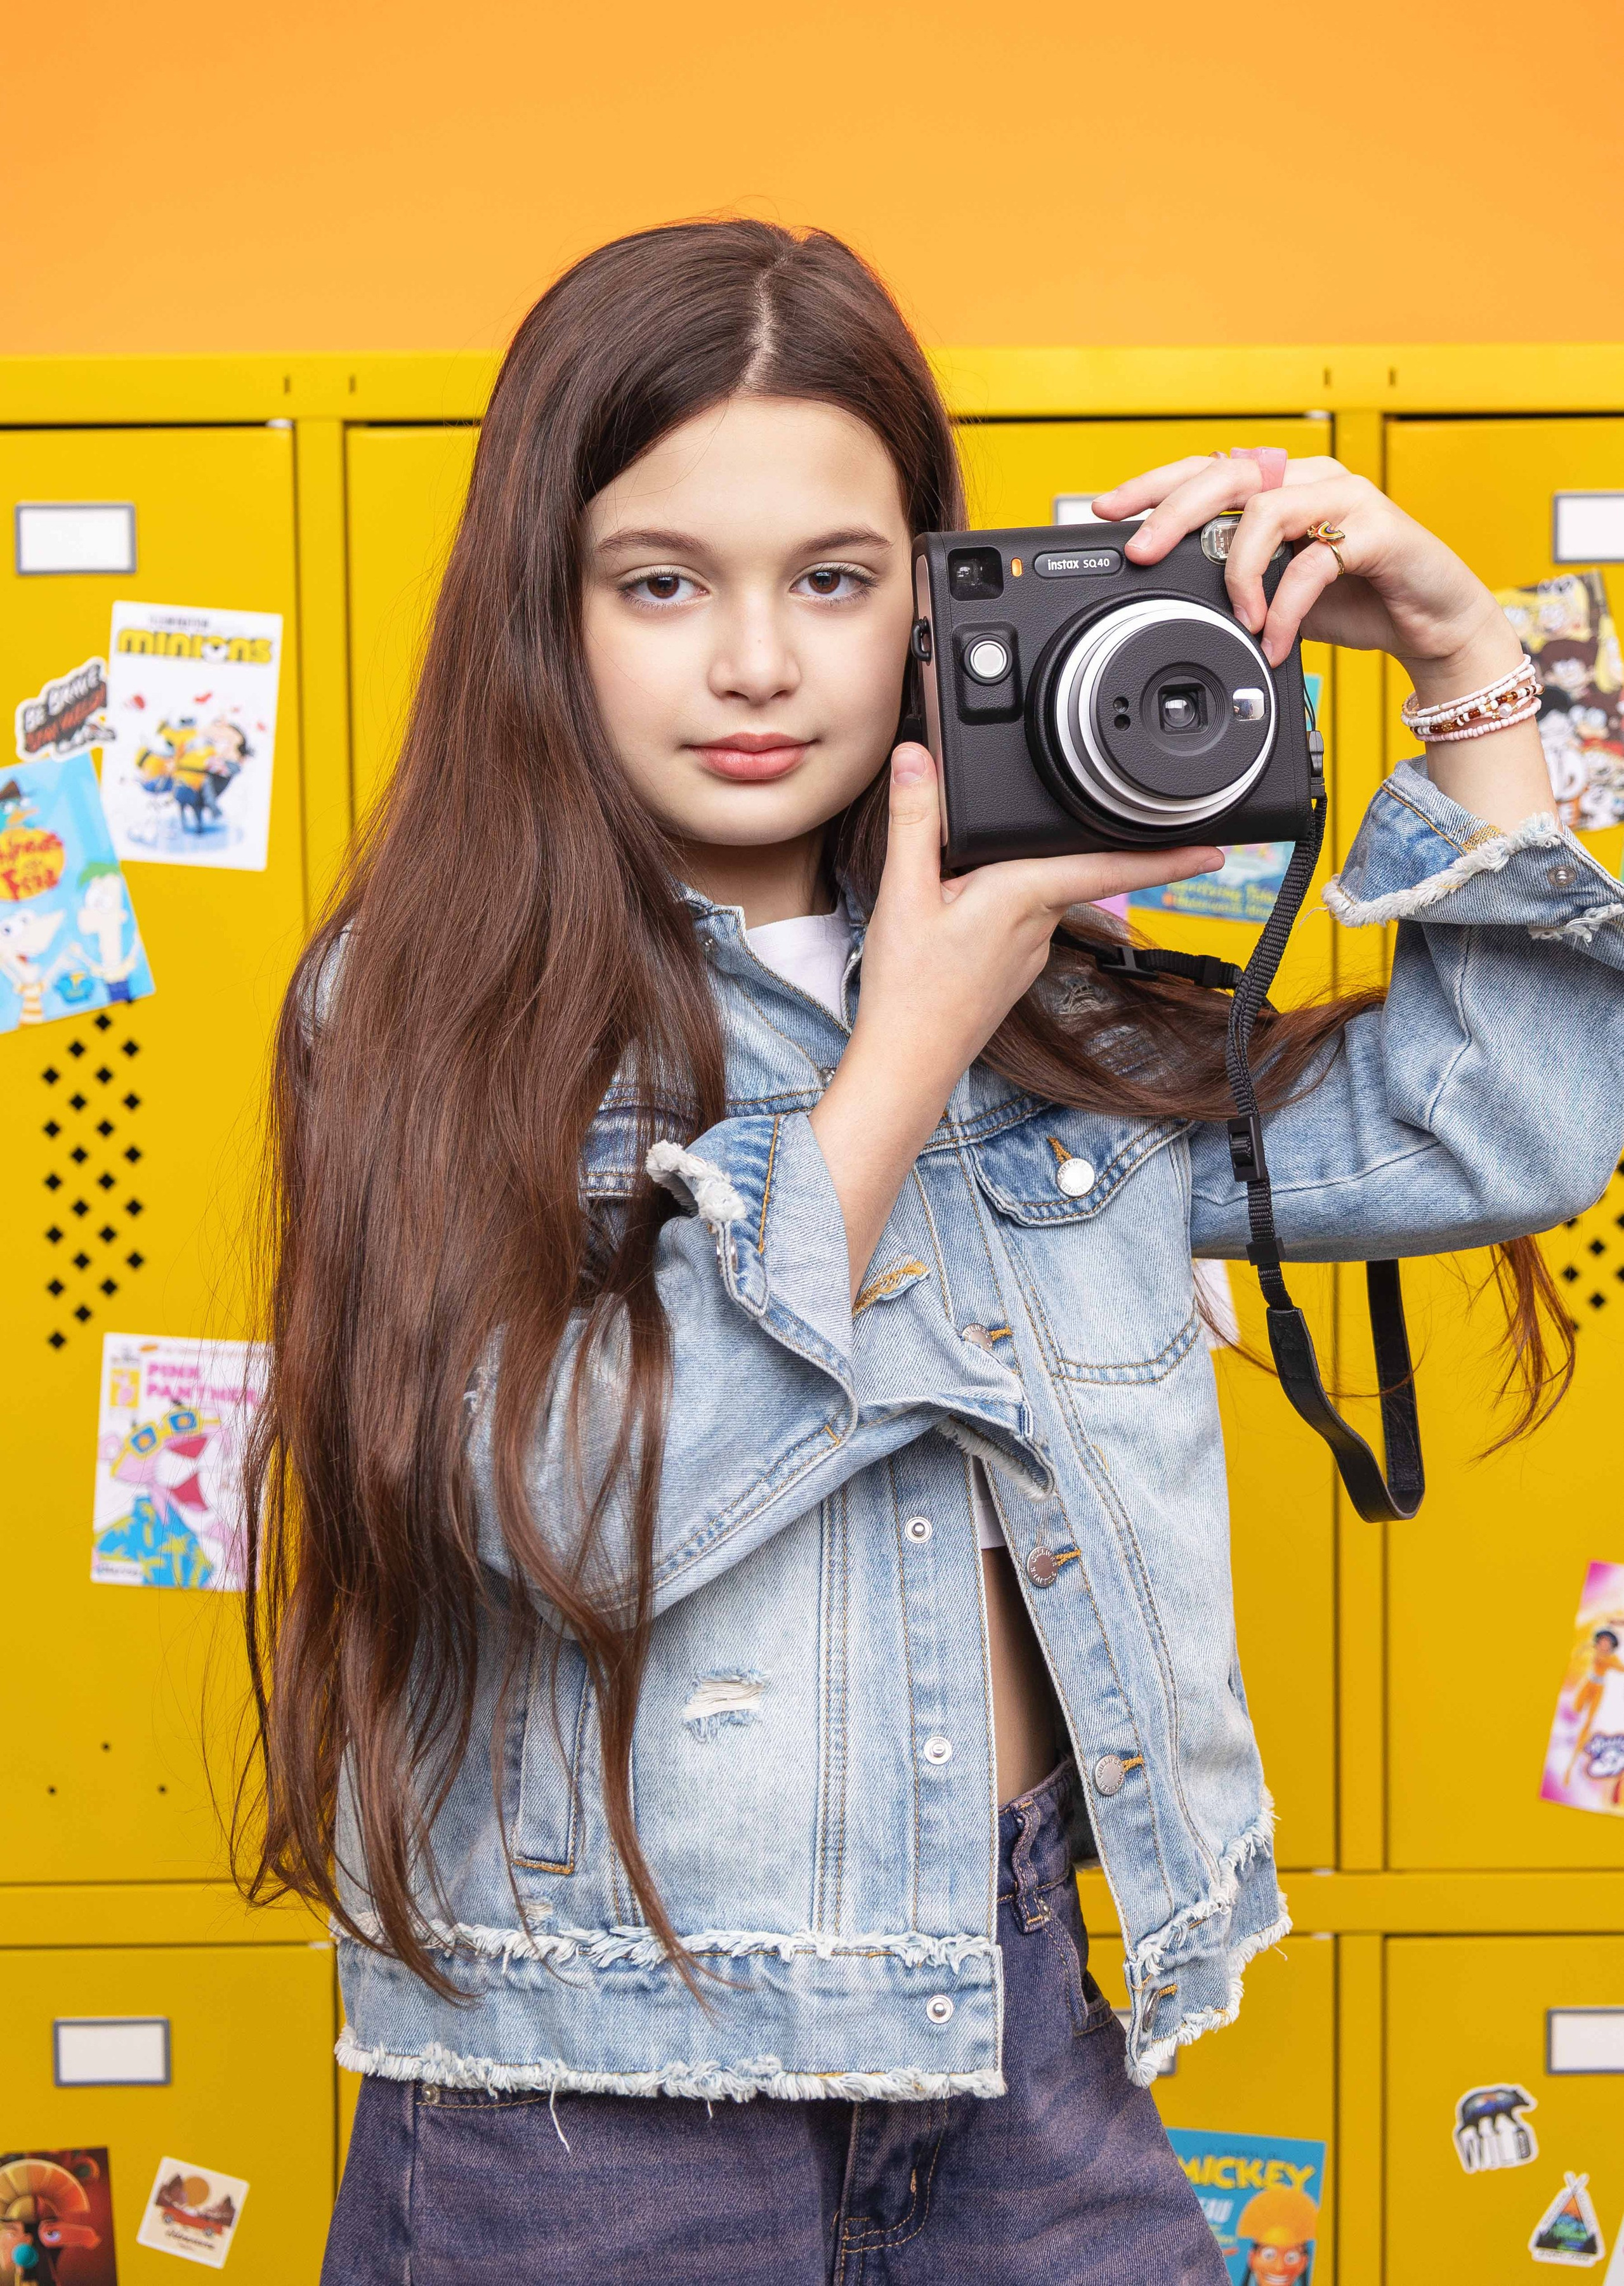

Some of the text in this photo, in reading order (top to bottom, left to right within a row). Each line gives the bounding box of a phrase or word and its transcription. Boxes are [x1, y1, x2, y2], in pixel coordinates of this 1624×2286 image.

[1047, 558, 1110, 570] instax SQ40
[147, 1362, 200, 1379] PINK
[1177, 2155, 1315, 2191] MICKEY
